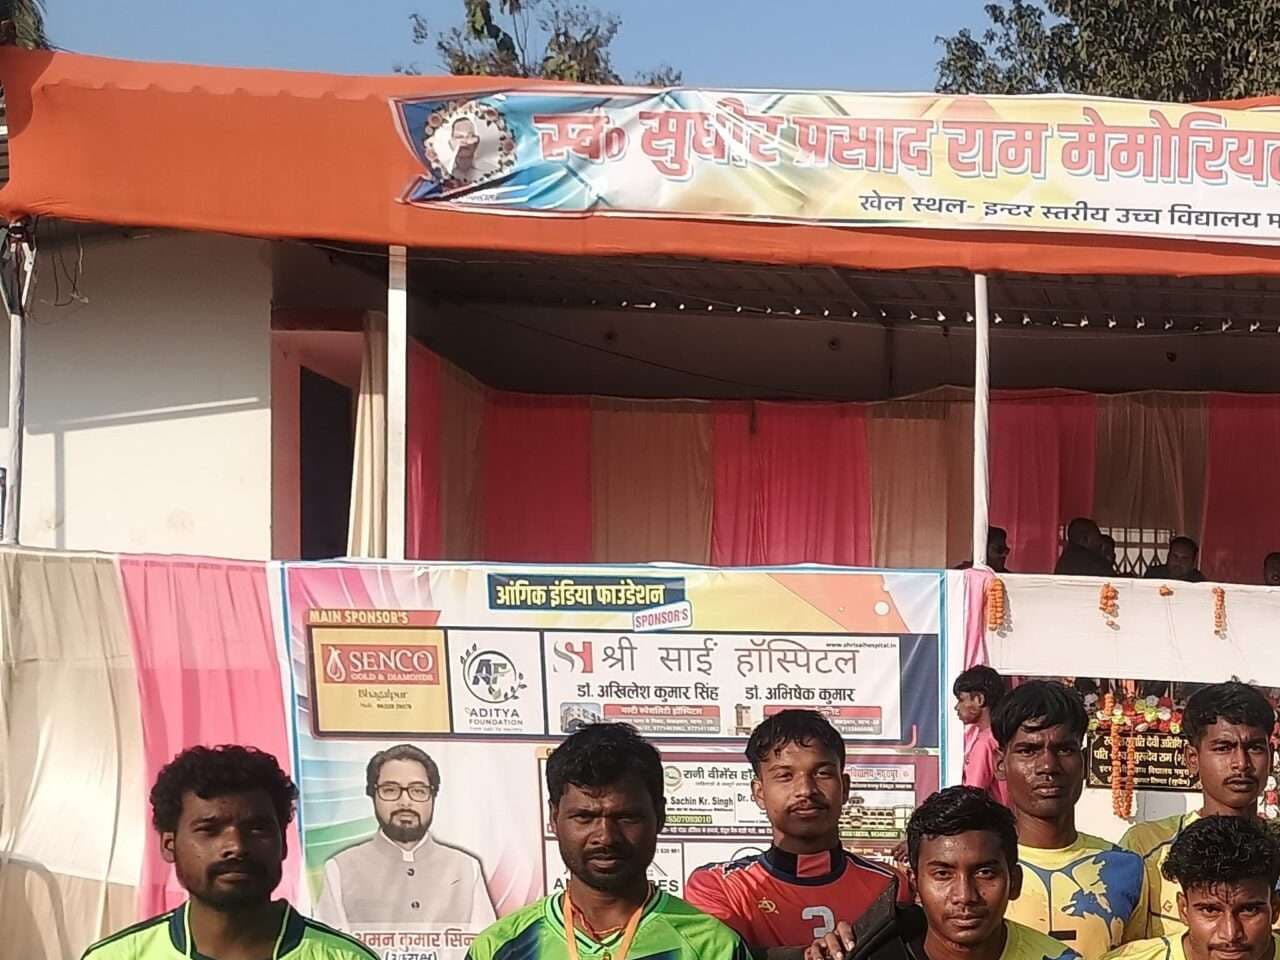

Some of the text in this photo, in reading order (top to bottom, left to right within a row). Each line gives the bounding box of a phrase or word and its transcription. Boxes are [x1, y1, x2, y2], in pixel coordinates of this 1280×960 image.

[942, 120, 1050, 174] राम
[859, 190, 905, 213] खेल
[982, 200, 1035, 218] इन्टर
[1041, 201, 1110, 223] स्तरीय
[1115, 207, 1163, 225] उच्च
[1168, 204, 1262, 228] विद्यालय
[496, 578, 666, 607] आंगिक इंडिया फाउंडेशन
[309, 610, 409, 625] MAIN SPONSOR'S
[635, 608, 689, 628] SPONSOR'S
[350, 649, 433, 672] SENCO
[601, 635, 860, 677] श्री साईं हॉस्पिटल
[597, 681, 651, 699] अखिलेश
[653, 685, 691, 702] कुमार
[694, 682, 720, 701] सिंह
[765, 683, 816, 701] अभिषेक
[818, 687, 856, 704] कुमार
[470, 707, 520, 718] ADITYA
[670, 796, 734, 808] Sachin Kr. Singh
[737, 793, 749, 802] Dr.
[399, 932, 441, 951] कुमार
